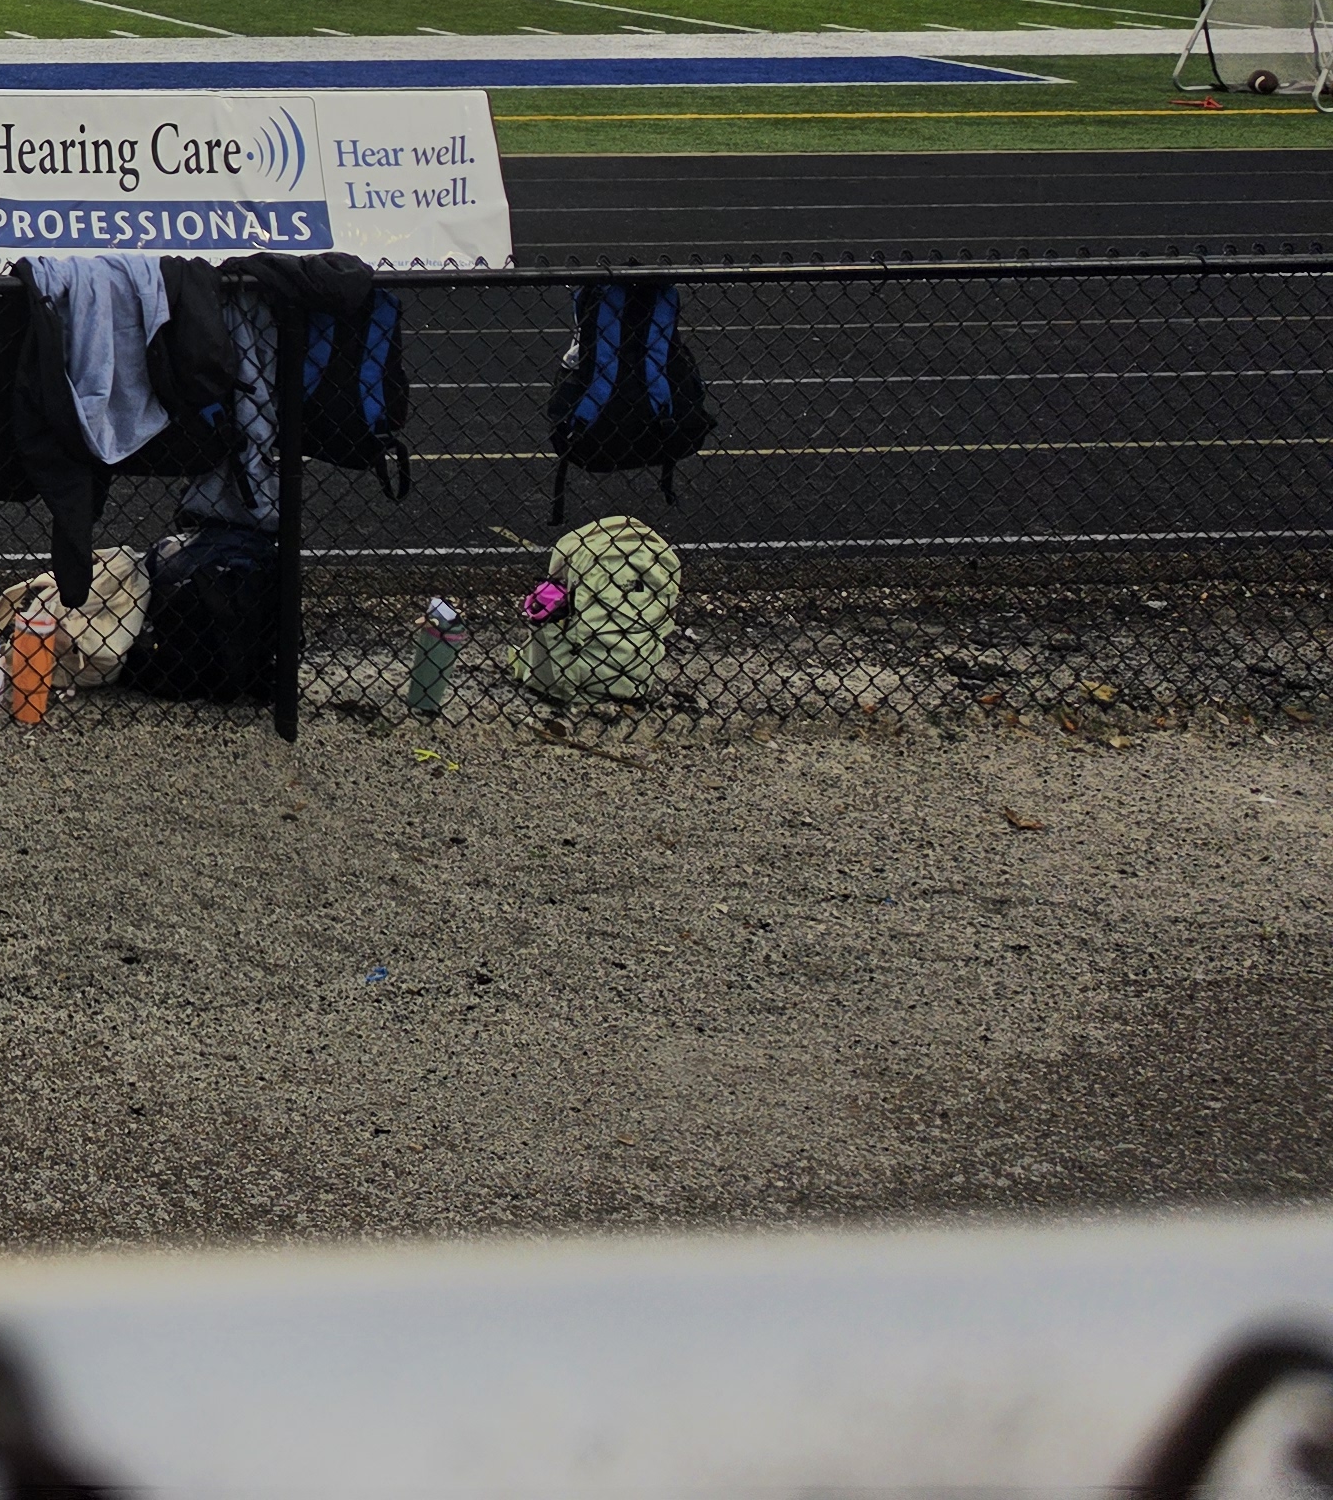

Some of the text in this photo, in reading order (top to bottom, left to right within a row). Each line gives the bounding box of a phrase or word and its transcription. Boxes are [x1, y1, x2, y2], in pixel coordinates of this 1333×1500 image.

[151, 122, 242, 175] Care
[333, 135, 475, 168] Hear well.
[345, 177, 476, 209] Live well.
